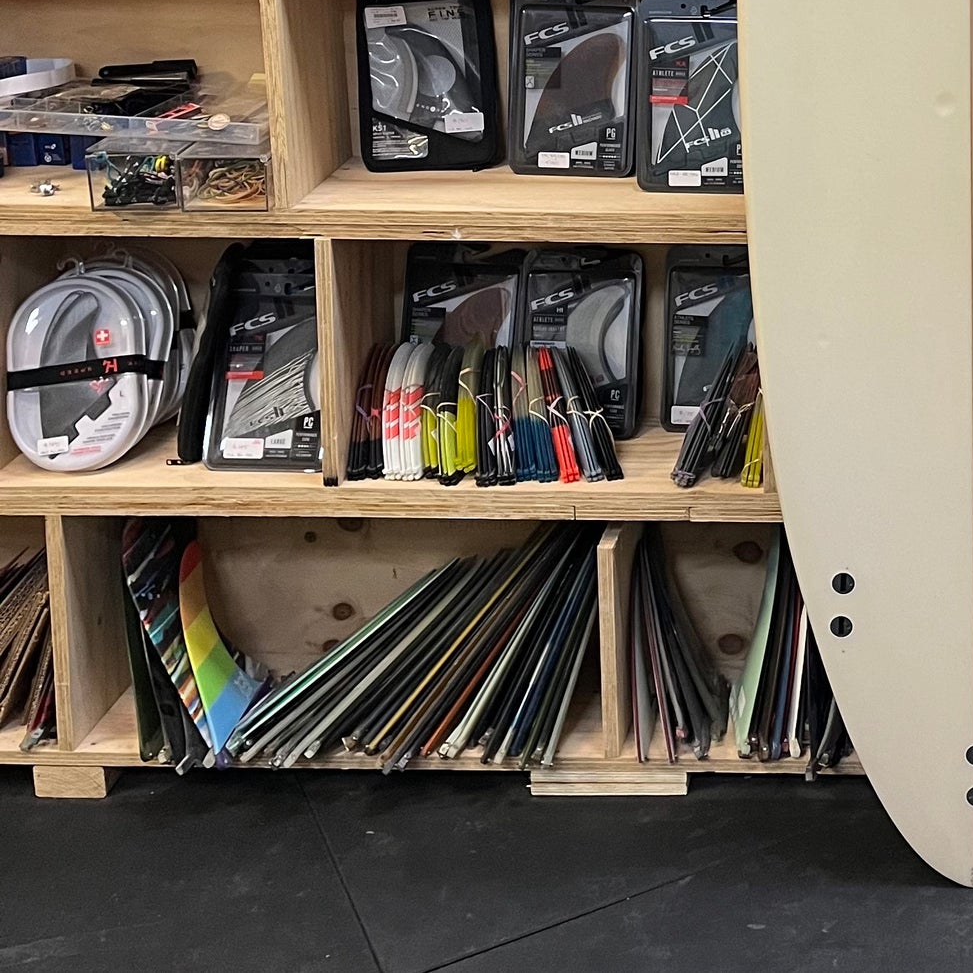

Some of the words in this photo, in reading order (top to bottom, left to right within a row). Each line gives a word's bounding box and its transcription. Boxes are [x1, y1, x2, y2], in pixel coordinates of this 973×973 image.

[524, 22, 569, 45] FCS
[649, 36, 695, 60] FCS
[606, 128, 616, 138] PG
[413, 281, 456, 302] FCS
[531, 288, 574, 310] FCS
[674, 283, 718, 307] FCS
[229, 312, 276, 336] FCS
[304, 417, 314, 427] PC
